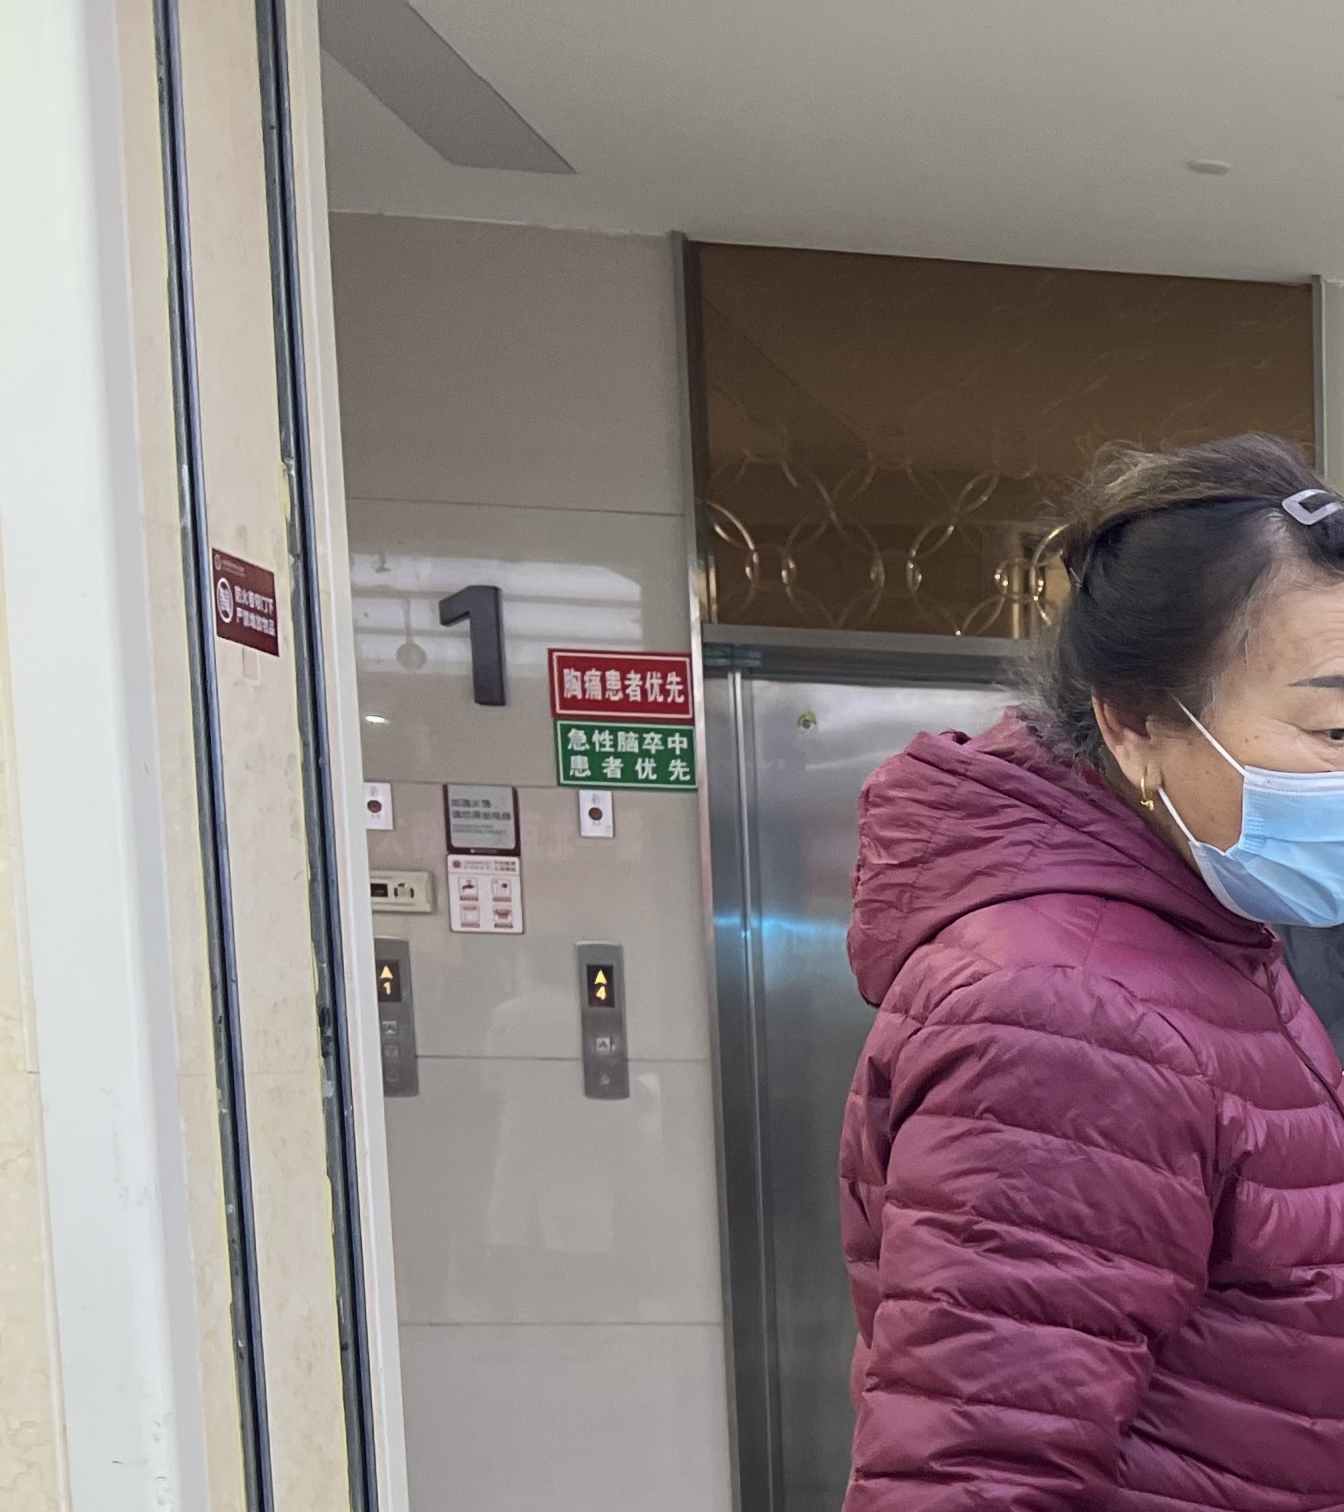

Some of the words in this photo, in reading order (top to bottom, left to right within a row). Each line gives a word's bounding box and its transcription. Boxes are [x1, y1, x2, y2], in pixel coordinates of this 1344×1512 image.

[440, 585, 506, 706] 1
[563, 668, 685, 704] 胸痛患者优先
[567, 728, 689, 755] 急性脑卒中
[569, 755, 691, 781] 患者优先
